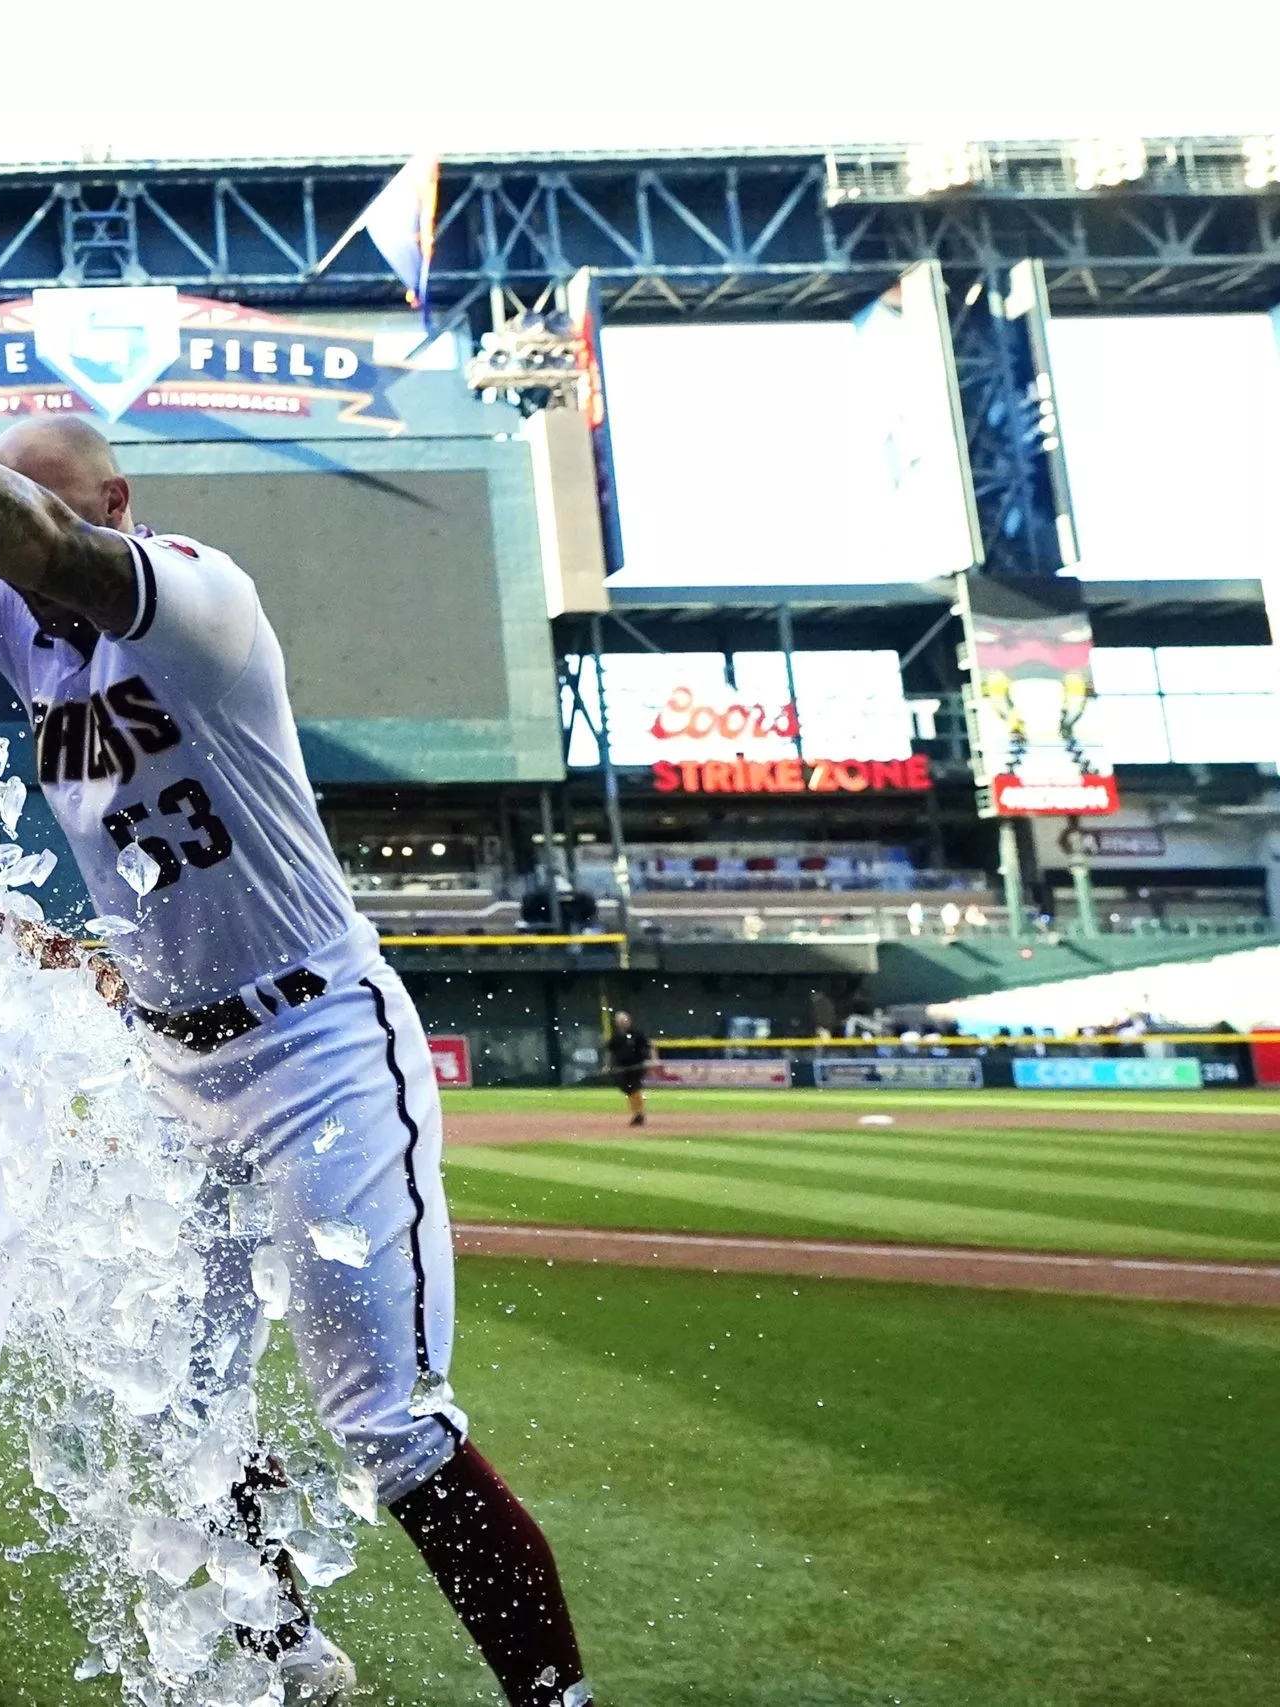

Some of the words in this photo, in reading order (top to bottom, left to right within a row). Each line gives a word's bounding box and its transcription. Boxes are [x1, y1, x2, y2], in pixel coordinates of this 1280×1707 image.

[189, 338, 359, 380] FIELD
[34, 394, 73, 409] THE
[147, 392, 300, 413] DIAMONDBACKS
[651, 686, 799, 740] Coors
[651, 759, 805, 793] STRIKE
[807, 754, 933, 792] ZONE
[102, 777, 233, 892] 53
